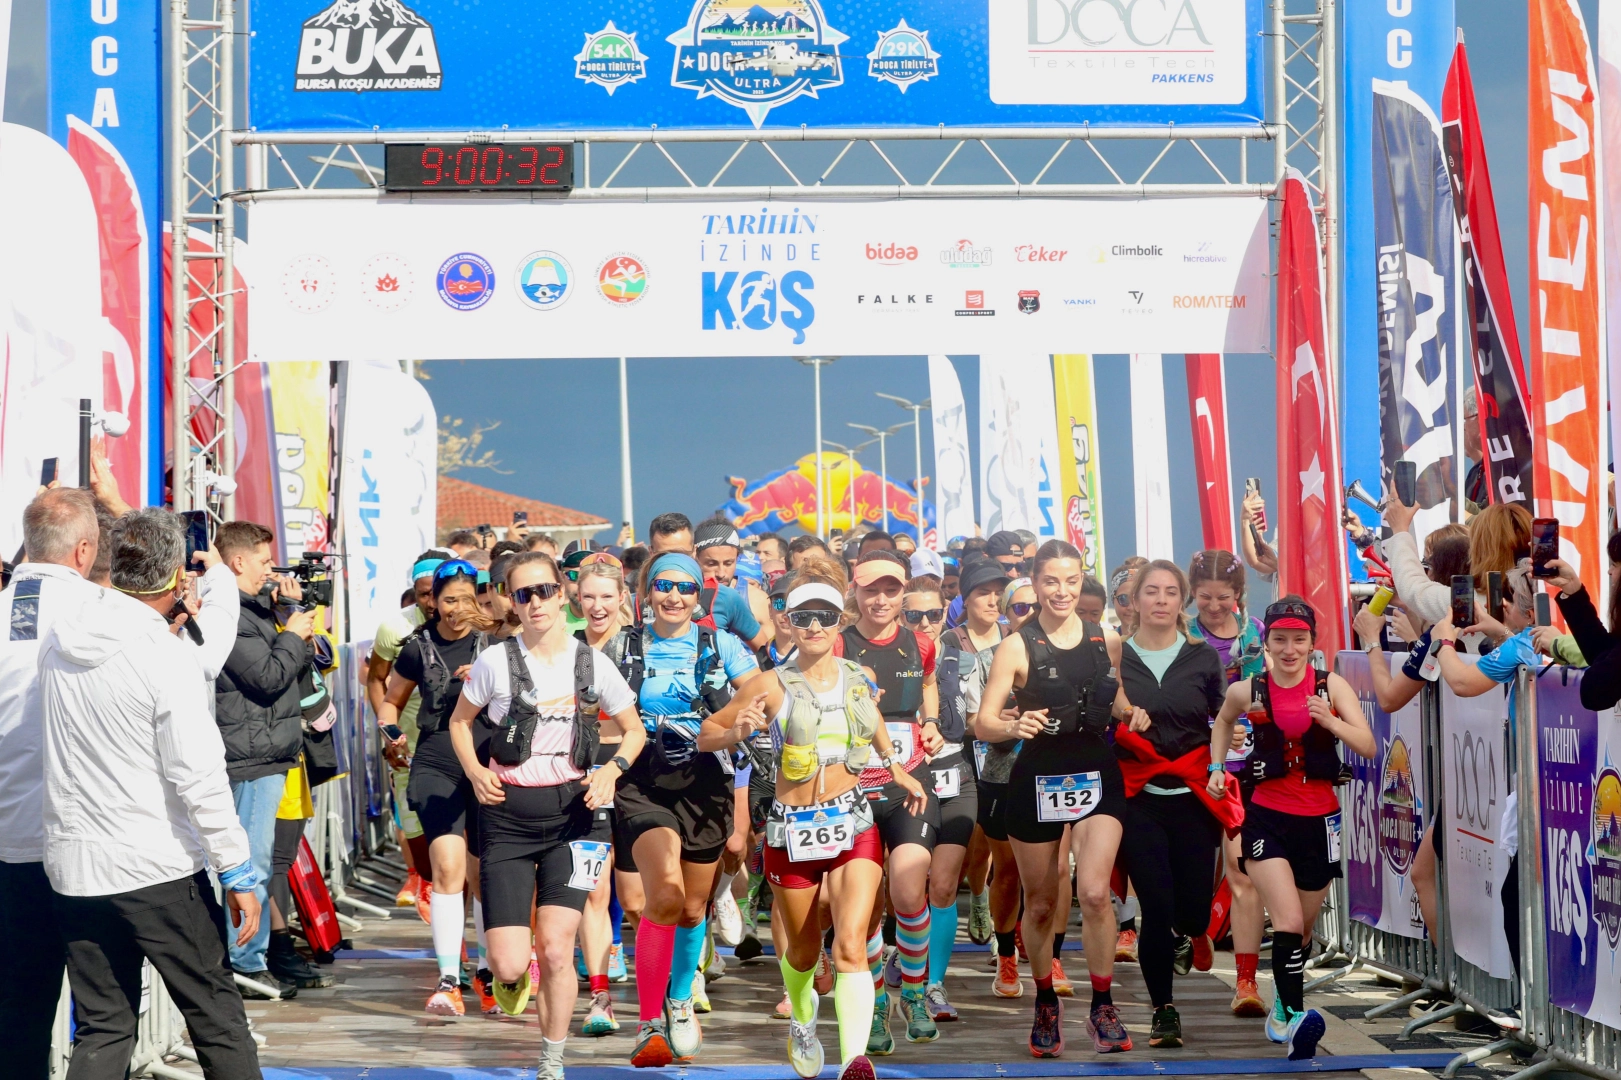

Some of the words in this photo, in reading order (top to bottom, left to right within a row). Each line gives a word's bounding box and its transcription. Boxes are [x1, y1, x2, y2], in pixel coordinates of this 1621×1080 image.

[297, 27, 441, 76] BUKA
[593, 43, 629, 58] 54K
[886, 41, 921, 56] 29K
[586, 62, 606, 71] DOCA
[879, 60, 898, 69] DOCA
[900, 59, 927, 69] TİRİLYE
[1029, 56, 1136, 68] Textile
[1149, 56, 1215, 68] Tech
[296, 78, 336, 89] BURSA
[338, 78, 373, 91] KOŞU
[374, 75, 441, 89] AKADEMİSİ
[735, 77, 781, 88] ULTRA
[1151, 73, 1214, 83] PAKKENS
[421, 147, 564, 185] 9:00:32
[701, 207, 819, 234] TARİHİN
[701, 239, 820, 261] İZİNDE
[1111, 245, 1163, 256] Climbolic
[1183, 254, 1228, 263] hicreative
[701, 270, 816, 345] KOŞ
[858, 294, 933, 304] FALKE
[1173, 295, 1247, 309] ROMATEM
[896, 669, 922, 678] naked
[506, 724, 518, 744] SILVA
[1544, 714, 1580, 765] TARİHİN
[1453, 729, 1496, 831] DOCA
[1048, 789, 1093, 808] 152
[1545, 772, 1584, 815] İZİNDE
[798, 823, 847, 847] 265
[1347, 778, 1377, 888] KOŞ
[1383, 816, 1398, 839] DOCA
[1547, 826, 1588, 966] KOŞ
